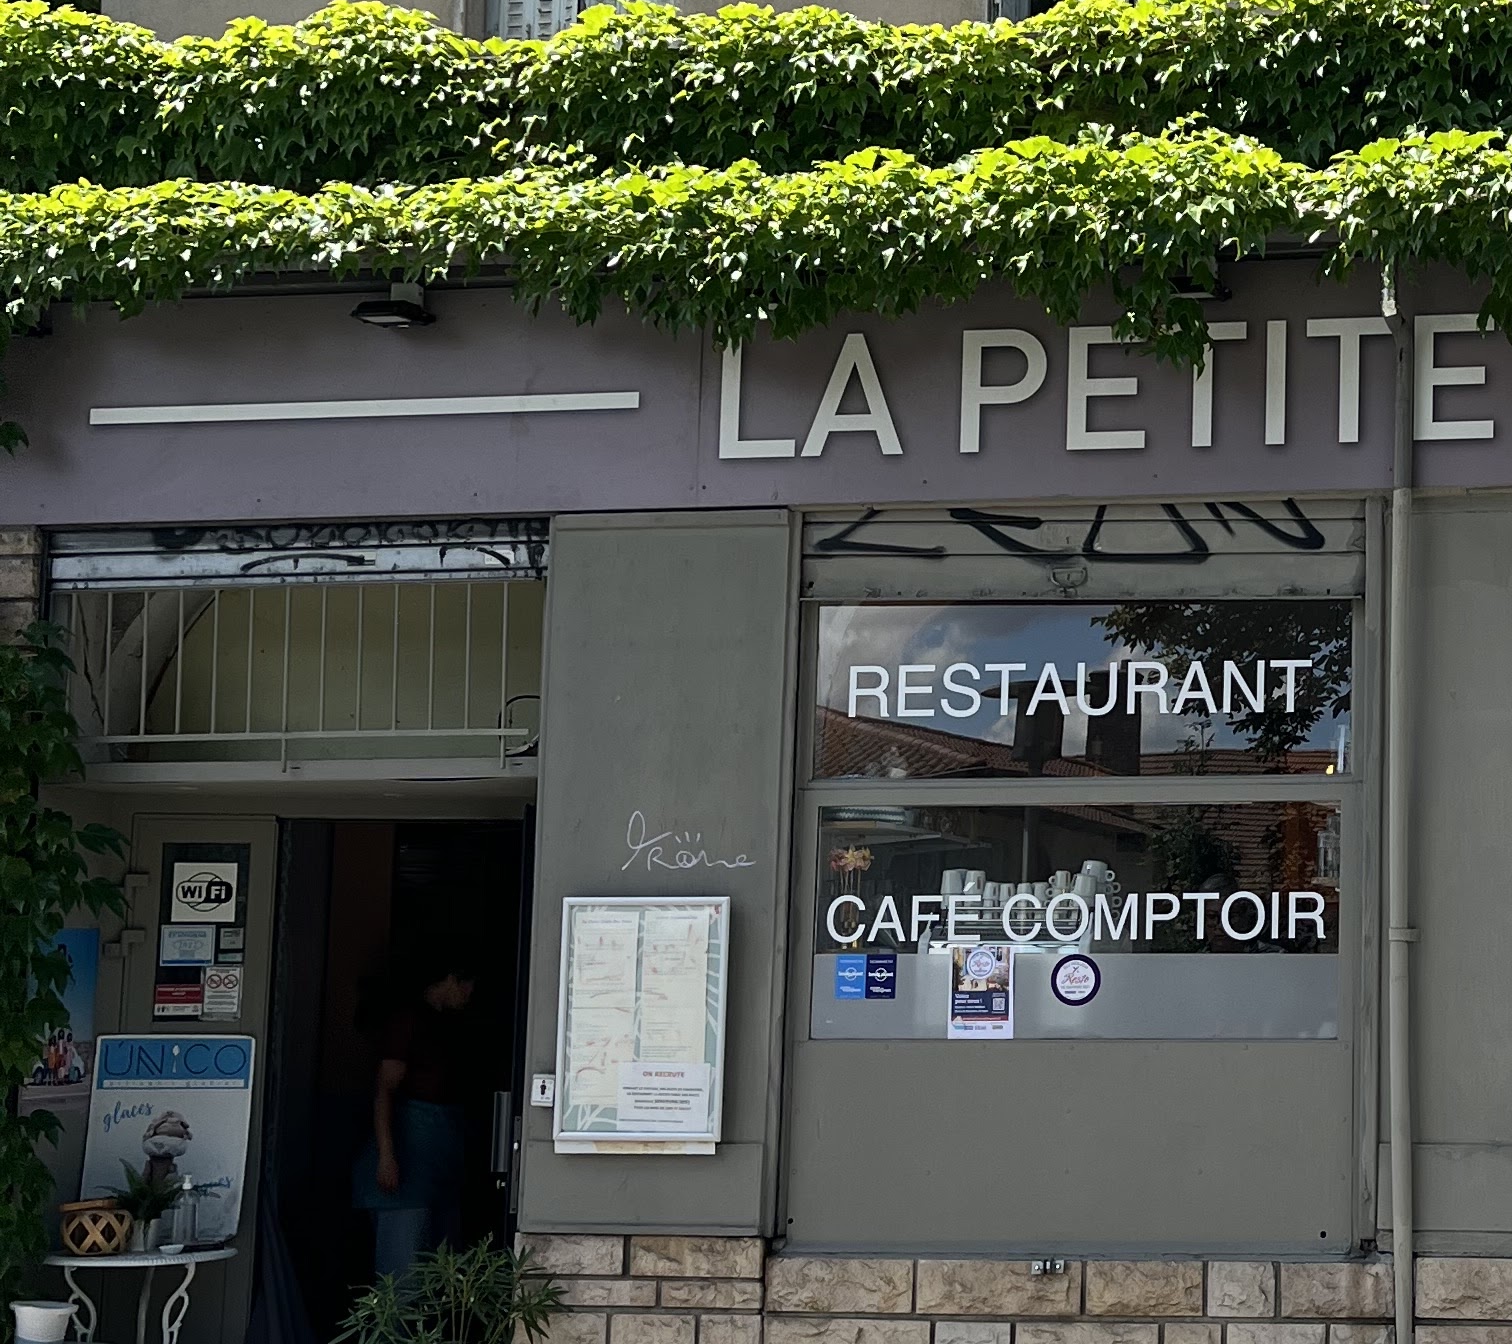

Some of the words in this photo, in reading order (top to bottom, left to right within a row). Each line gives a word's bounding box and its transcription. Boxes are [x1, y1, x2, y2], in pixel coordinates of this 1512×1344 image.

[719, 332, 903, 460] LA
[959, 313, 1496, 454] PETITE
[847, 658, 1313, 719] RESTAURANT
[826, 881, 982, 943] CAFÉ
[1002, 890, 1327, 942] COMPTOIR
[102, 1101, 154, 1133] glaces
